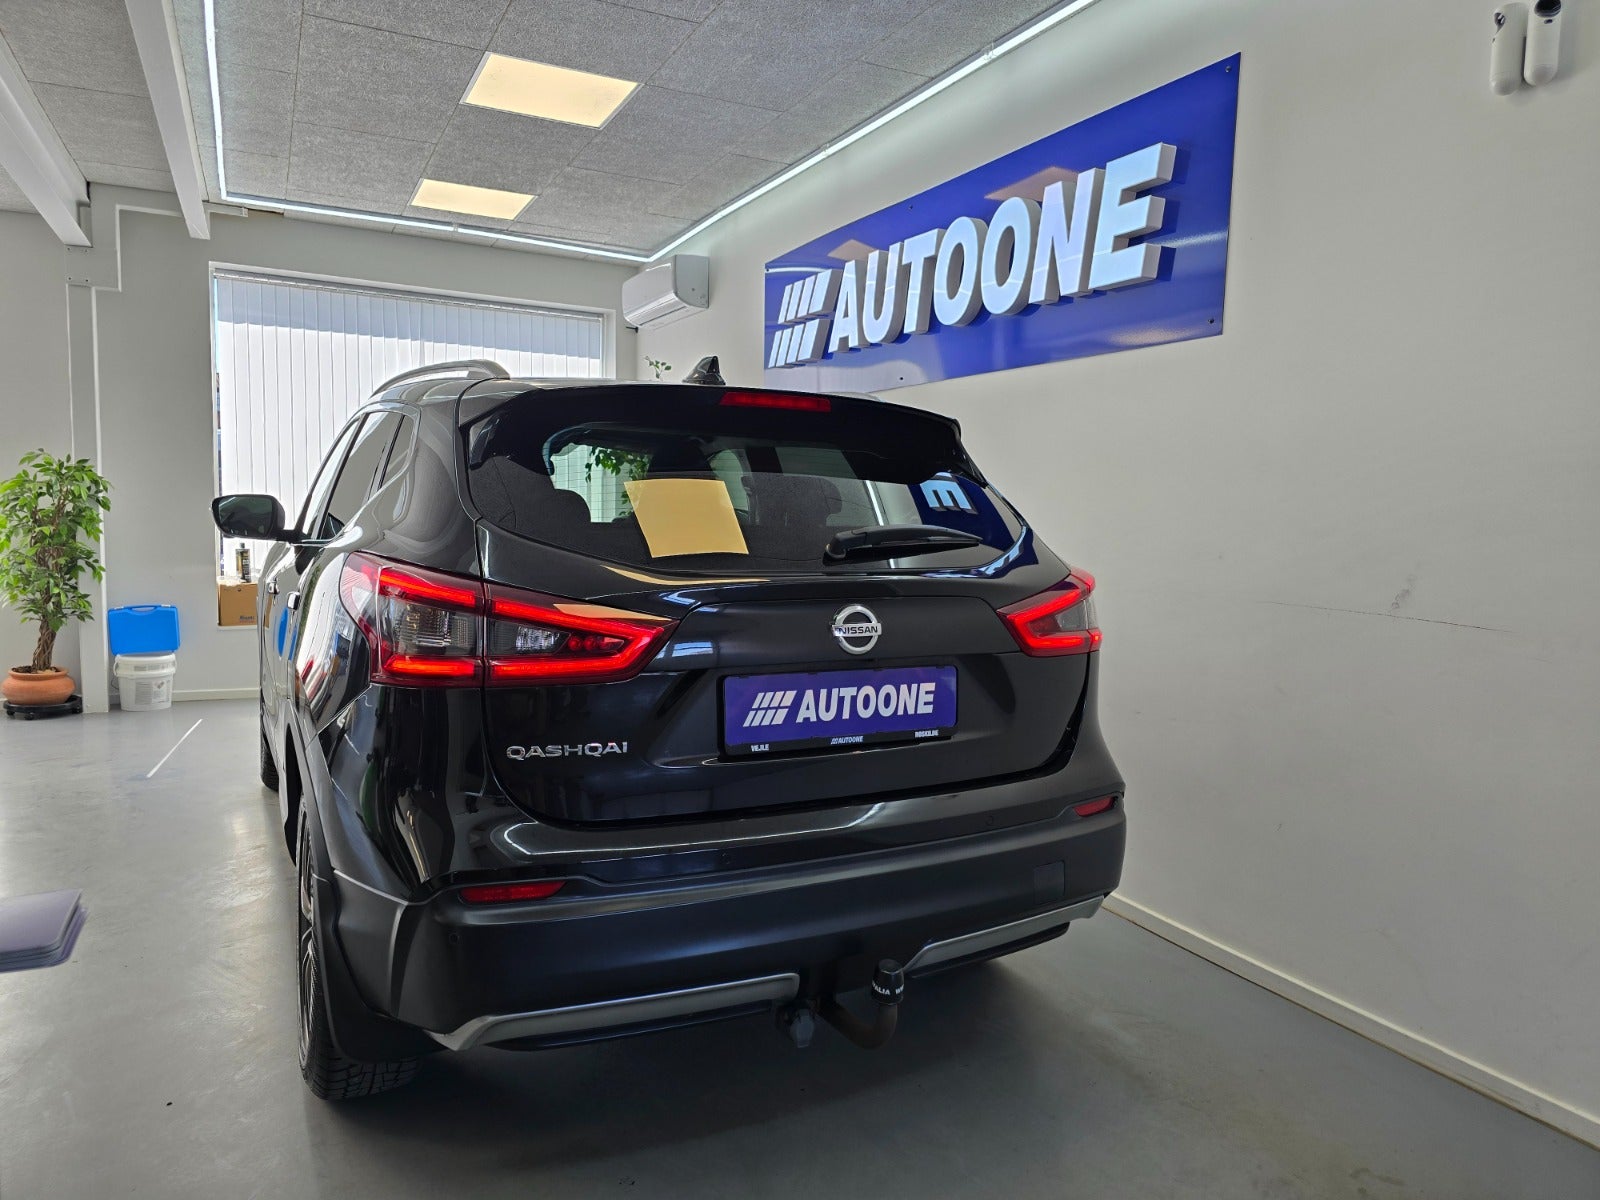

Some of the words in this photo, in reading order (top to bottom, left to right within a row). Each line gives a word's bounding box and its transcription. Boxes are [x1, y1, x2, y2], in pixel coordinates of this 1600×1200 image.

[828, 142, 1176, 353] AUTOONE
[838, 626, 878, 635] NISSAN
[795, 682, 936, 723] AUTOONE
[838, 736, 864, 744] AUTOONE
[506, 741, 628, 761] QASHQAI
[750, 744, 770, 752] VEJLE
